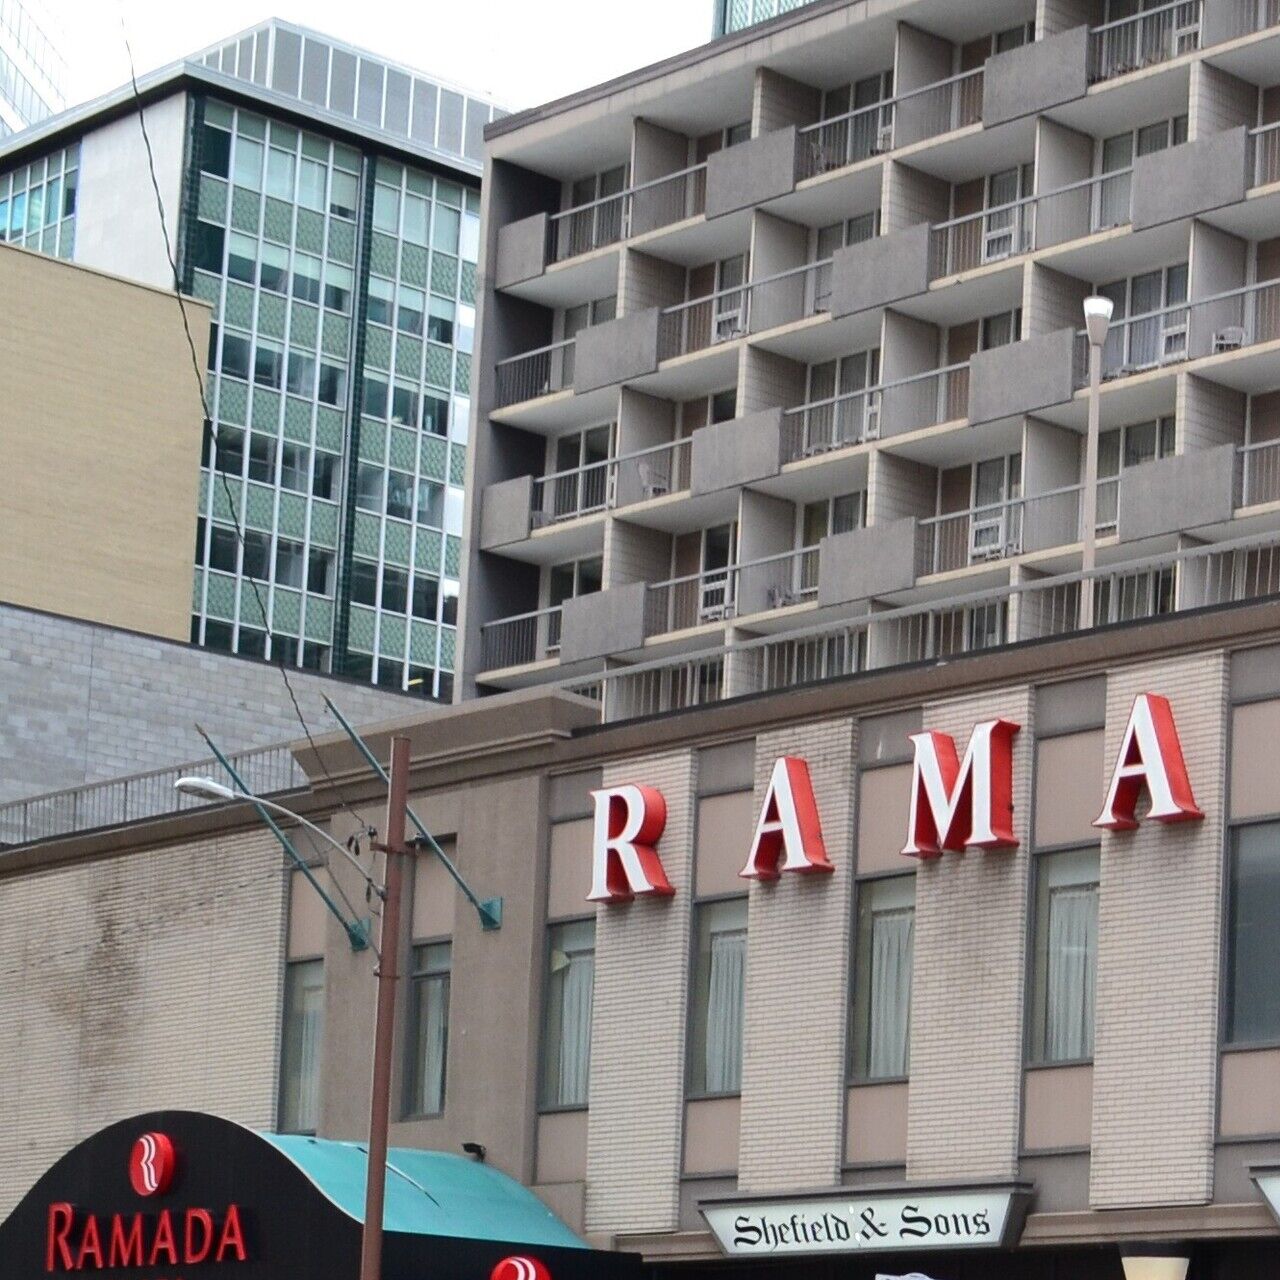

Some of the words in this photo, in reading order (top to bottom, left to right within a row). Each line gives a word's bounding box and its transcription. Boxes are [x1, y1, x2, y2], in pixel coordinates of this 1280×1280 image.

[46, 1202, 248, 1273] RAMADA
[733, 1212, 851, 1251] Shefield
[860, 1206, 890, 1241] &
[899, 1204, 992, 1239] Sons
